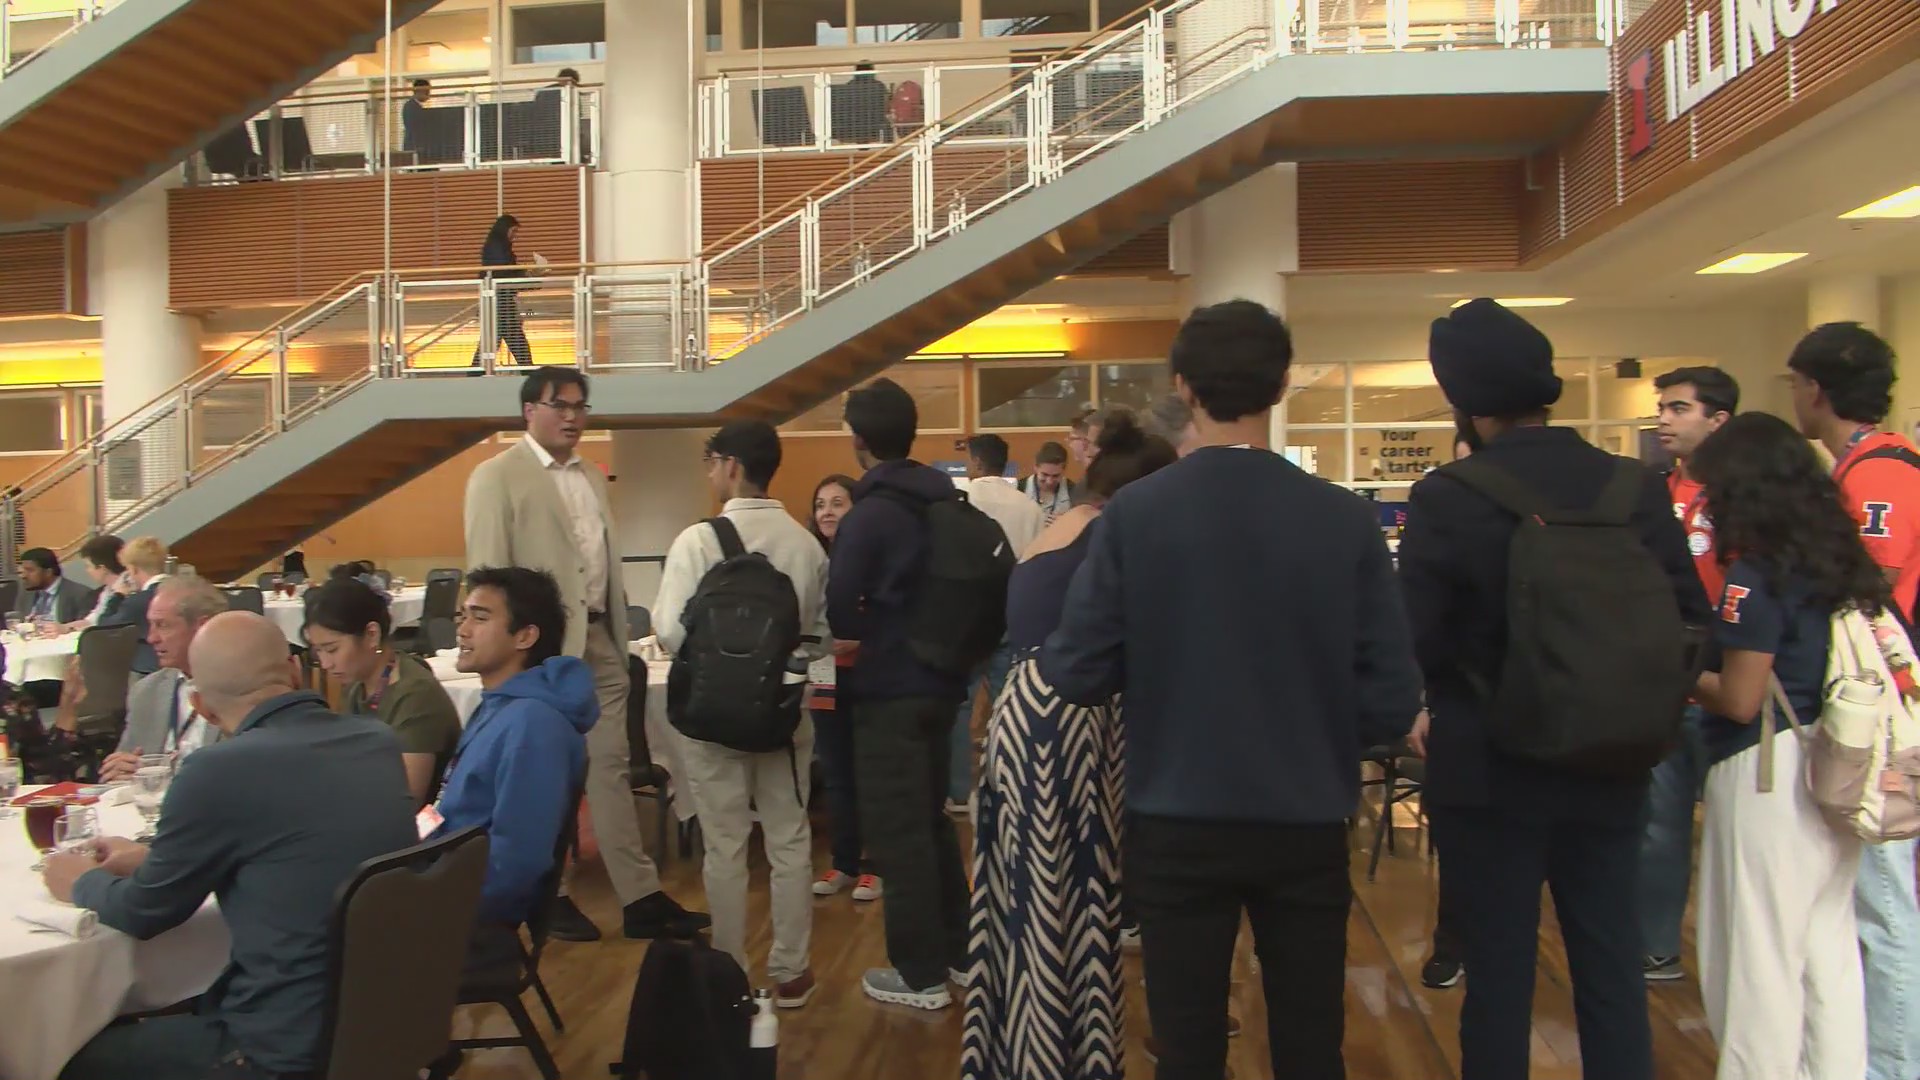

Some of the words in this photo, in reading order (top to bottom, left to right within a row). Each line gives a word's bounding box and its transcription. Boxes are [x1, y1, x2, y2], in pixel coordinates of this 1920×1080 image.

[1663, 0, 1838, 124] ILLIN
[1381, 430, 1417, 441] Your
[1380, 446, 1433, 457] career
[1382, 461, 1426, 473] tarts
[1859, 501, 1893, 538] I
